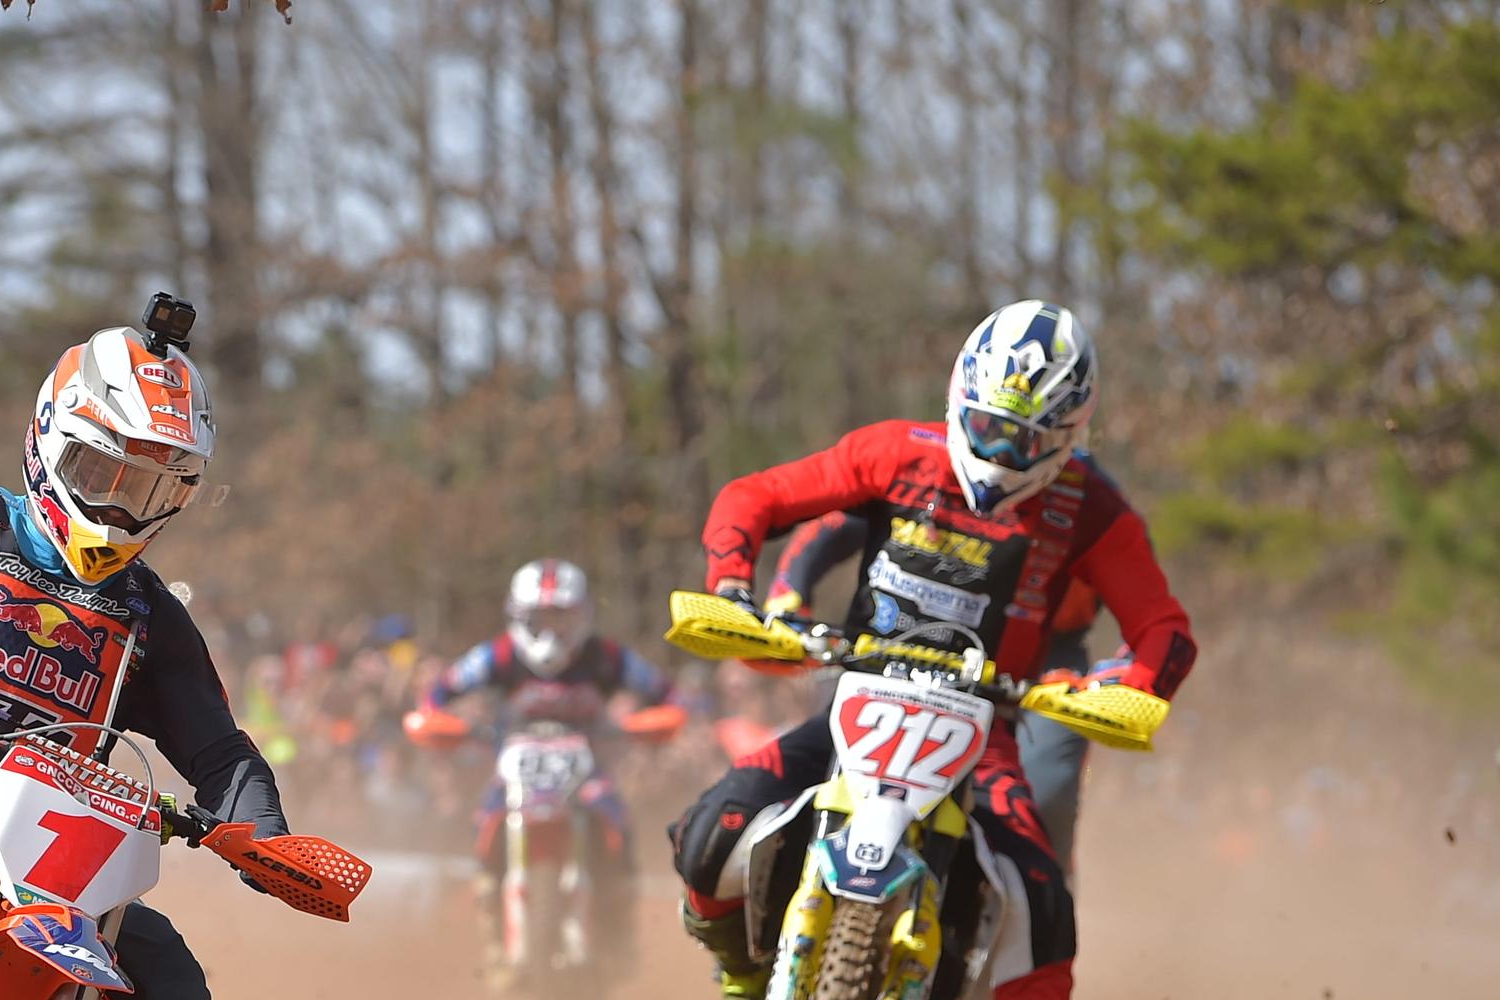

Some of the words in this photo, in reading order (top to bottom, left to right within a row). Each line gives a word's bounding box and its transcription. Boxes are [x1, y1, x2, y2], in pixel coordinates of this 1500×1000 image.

[142, 366, 178, 385] BELL
[150, 404, 188, 421] KTM
[155, 425, 191, 442] BELL
[31, 570, 59, 594] Lee
[55, 584, 131, 617] Designs
[29, 653, 101, 713] Bull
[848, 699, 977, 788] 212
[36, 761, 156, 830] GNCCRACING.CM
[22, 809, 128, 904] 1
[242, 850, 324, 891] ACERBIS
[42, 943, 120, 981] KTM
